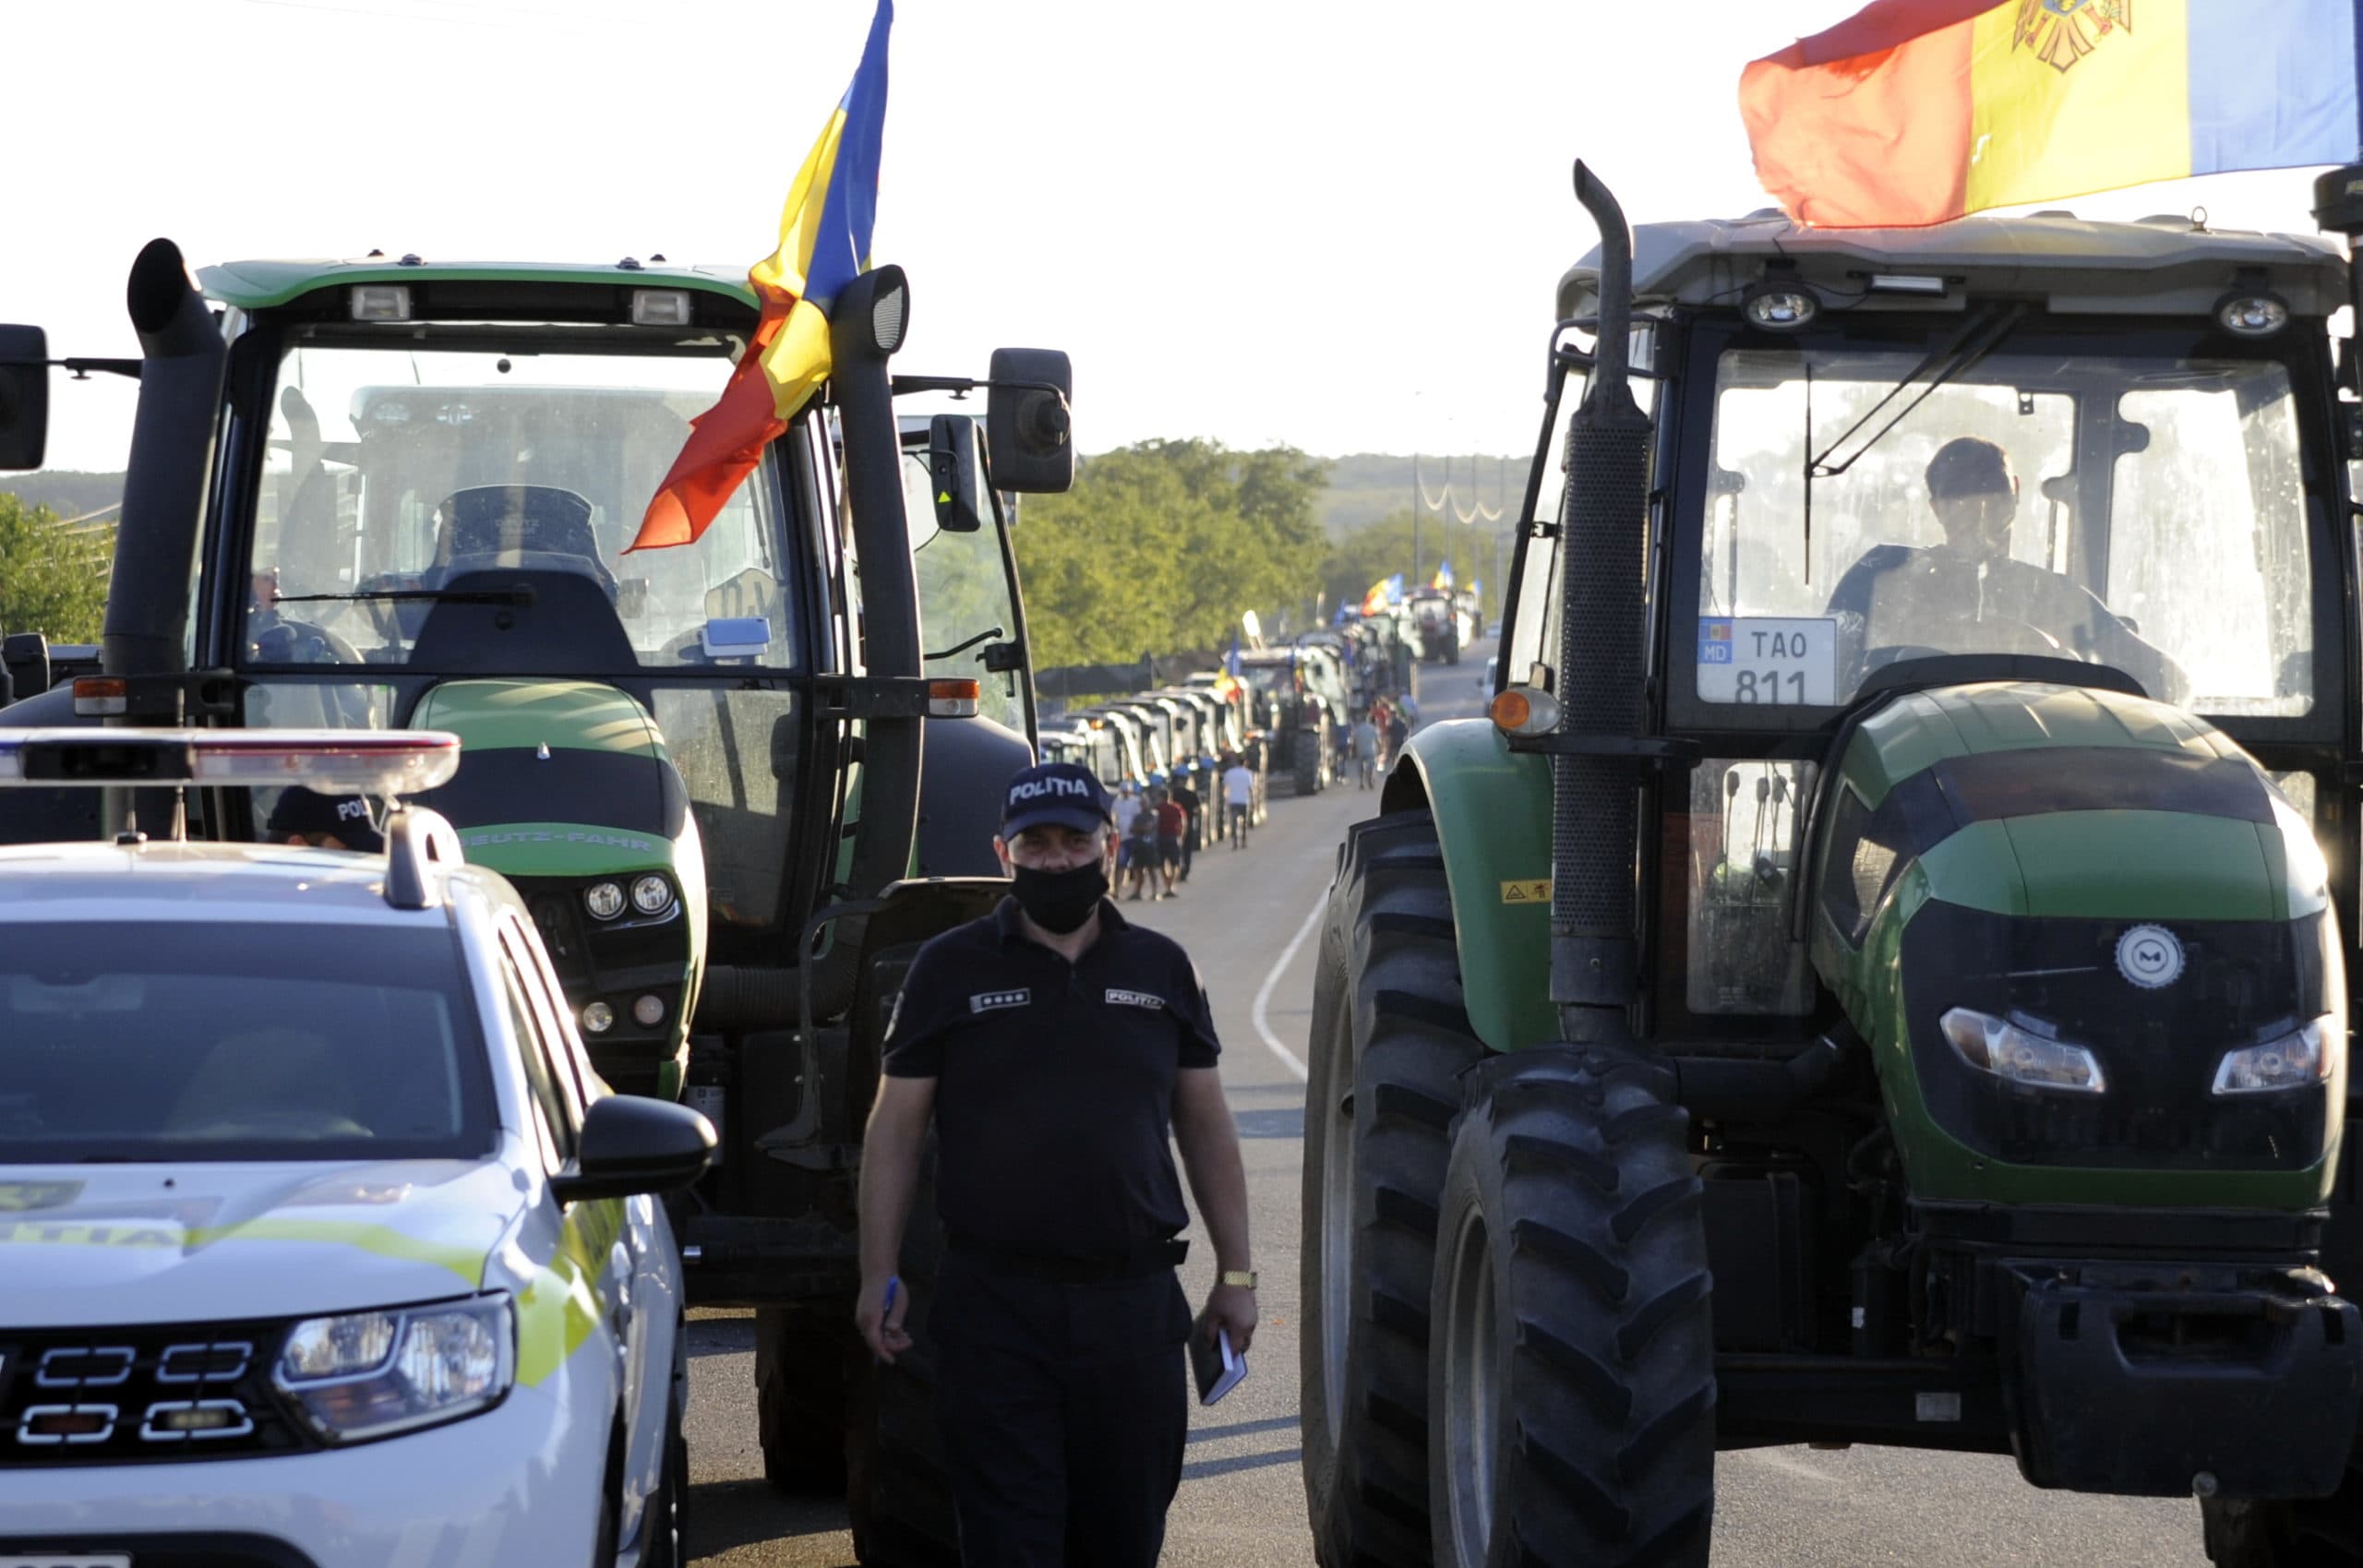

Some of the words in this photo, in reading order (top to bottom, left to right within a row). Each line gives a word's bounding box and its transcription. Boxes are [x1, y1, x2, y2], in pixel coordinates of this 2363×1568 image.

[1704, 645, 1727, 661] MD
[1734, 670, 1805, 704] 811
[462, 832, 651, 851] EUTZ-FAHR
